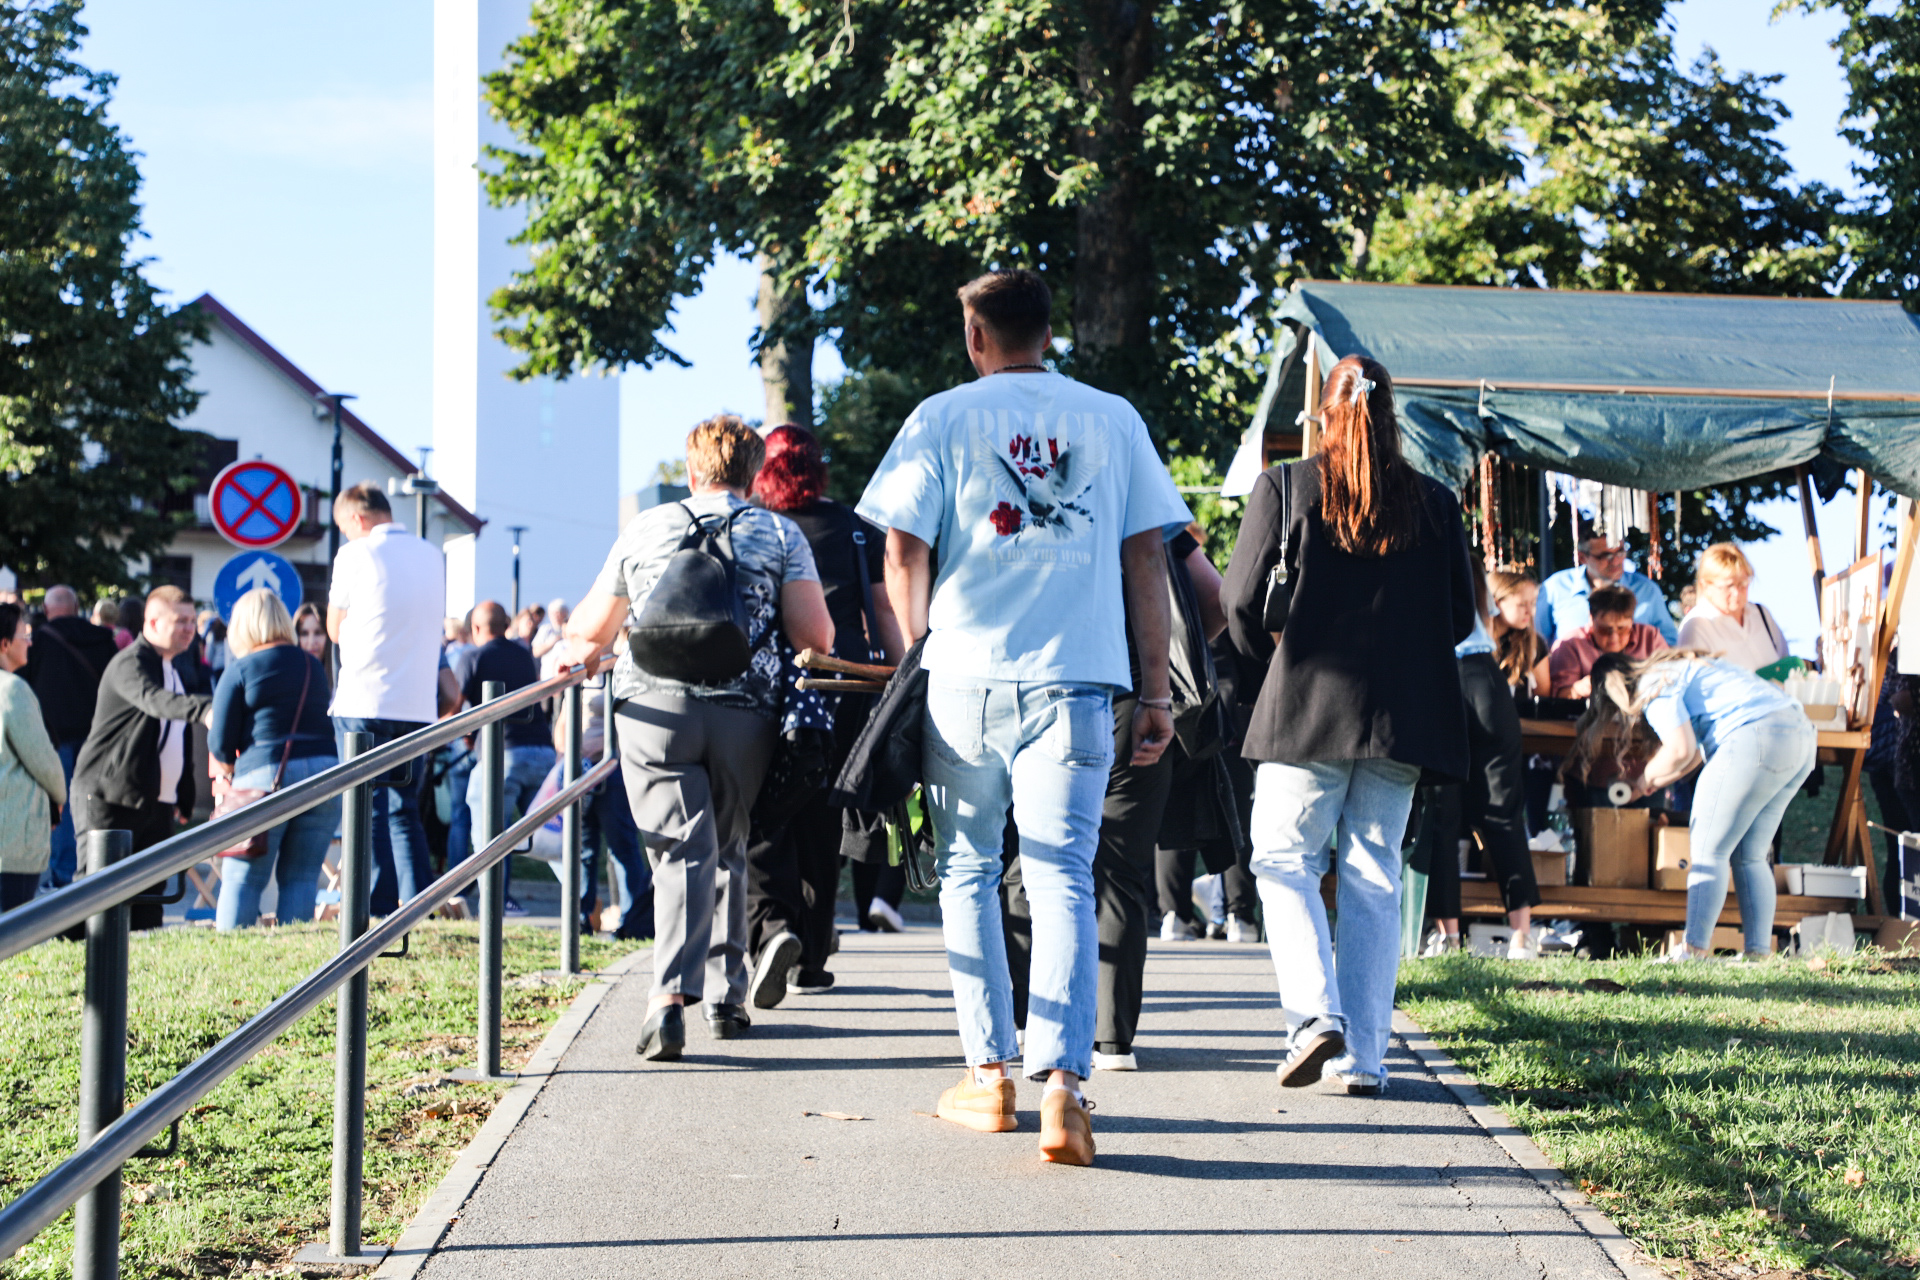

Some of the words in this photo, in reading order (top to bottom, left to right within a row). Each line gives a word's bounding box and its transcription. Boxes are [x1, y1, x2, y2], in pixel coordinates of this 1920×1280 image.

[966, 408, 1109, 467] PEACE
[988, 547, 1027, 561] ENJOY
[1031, 548, 1058, 561] THE
[1061, 549, 1092, 565] WIND
